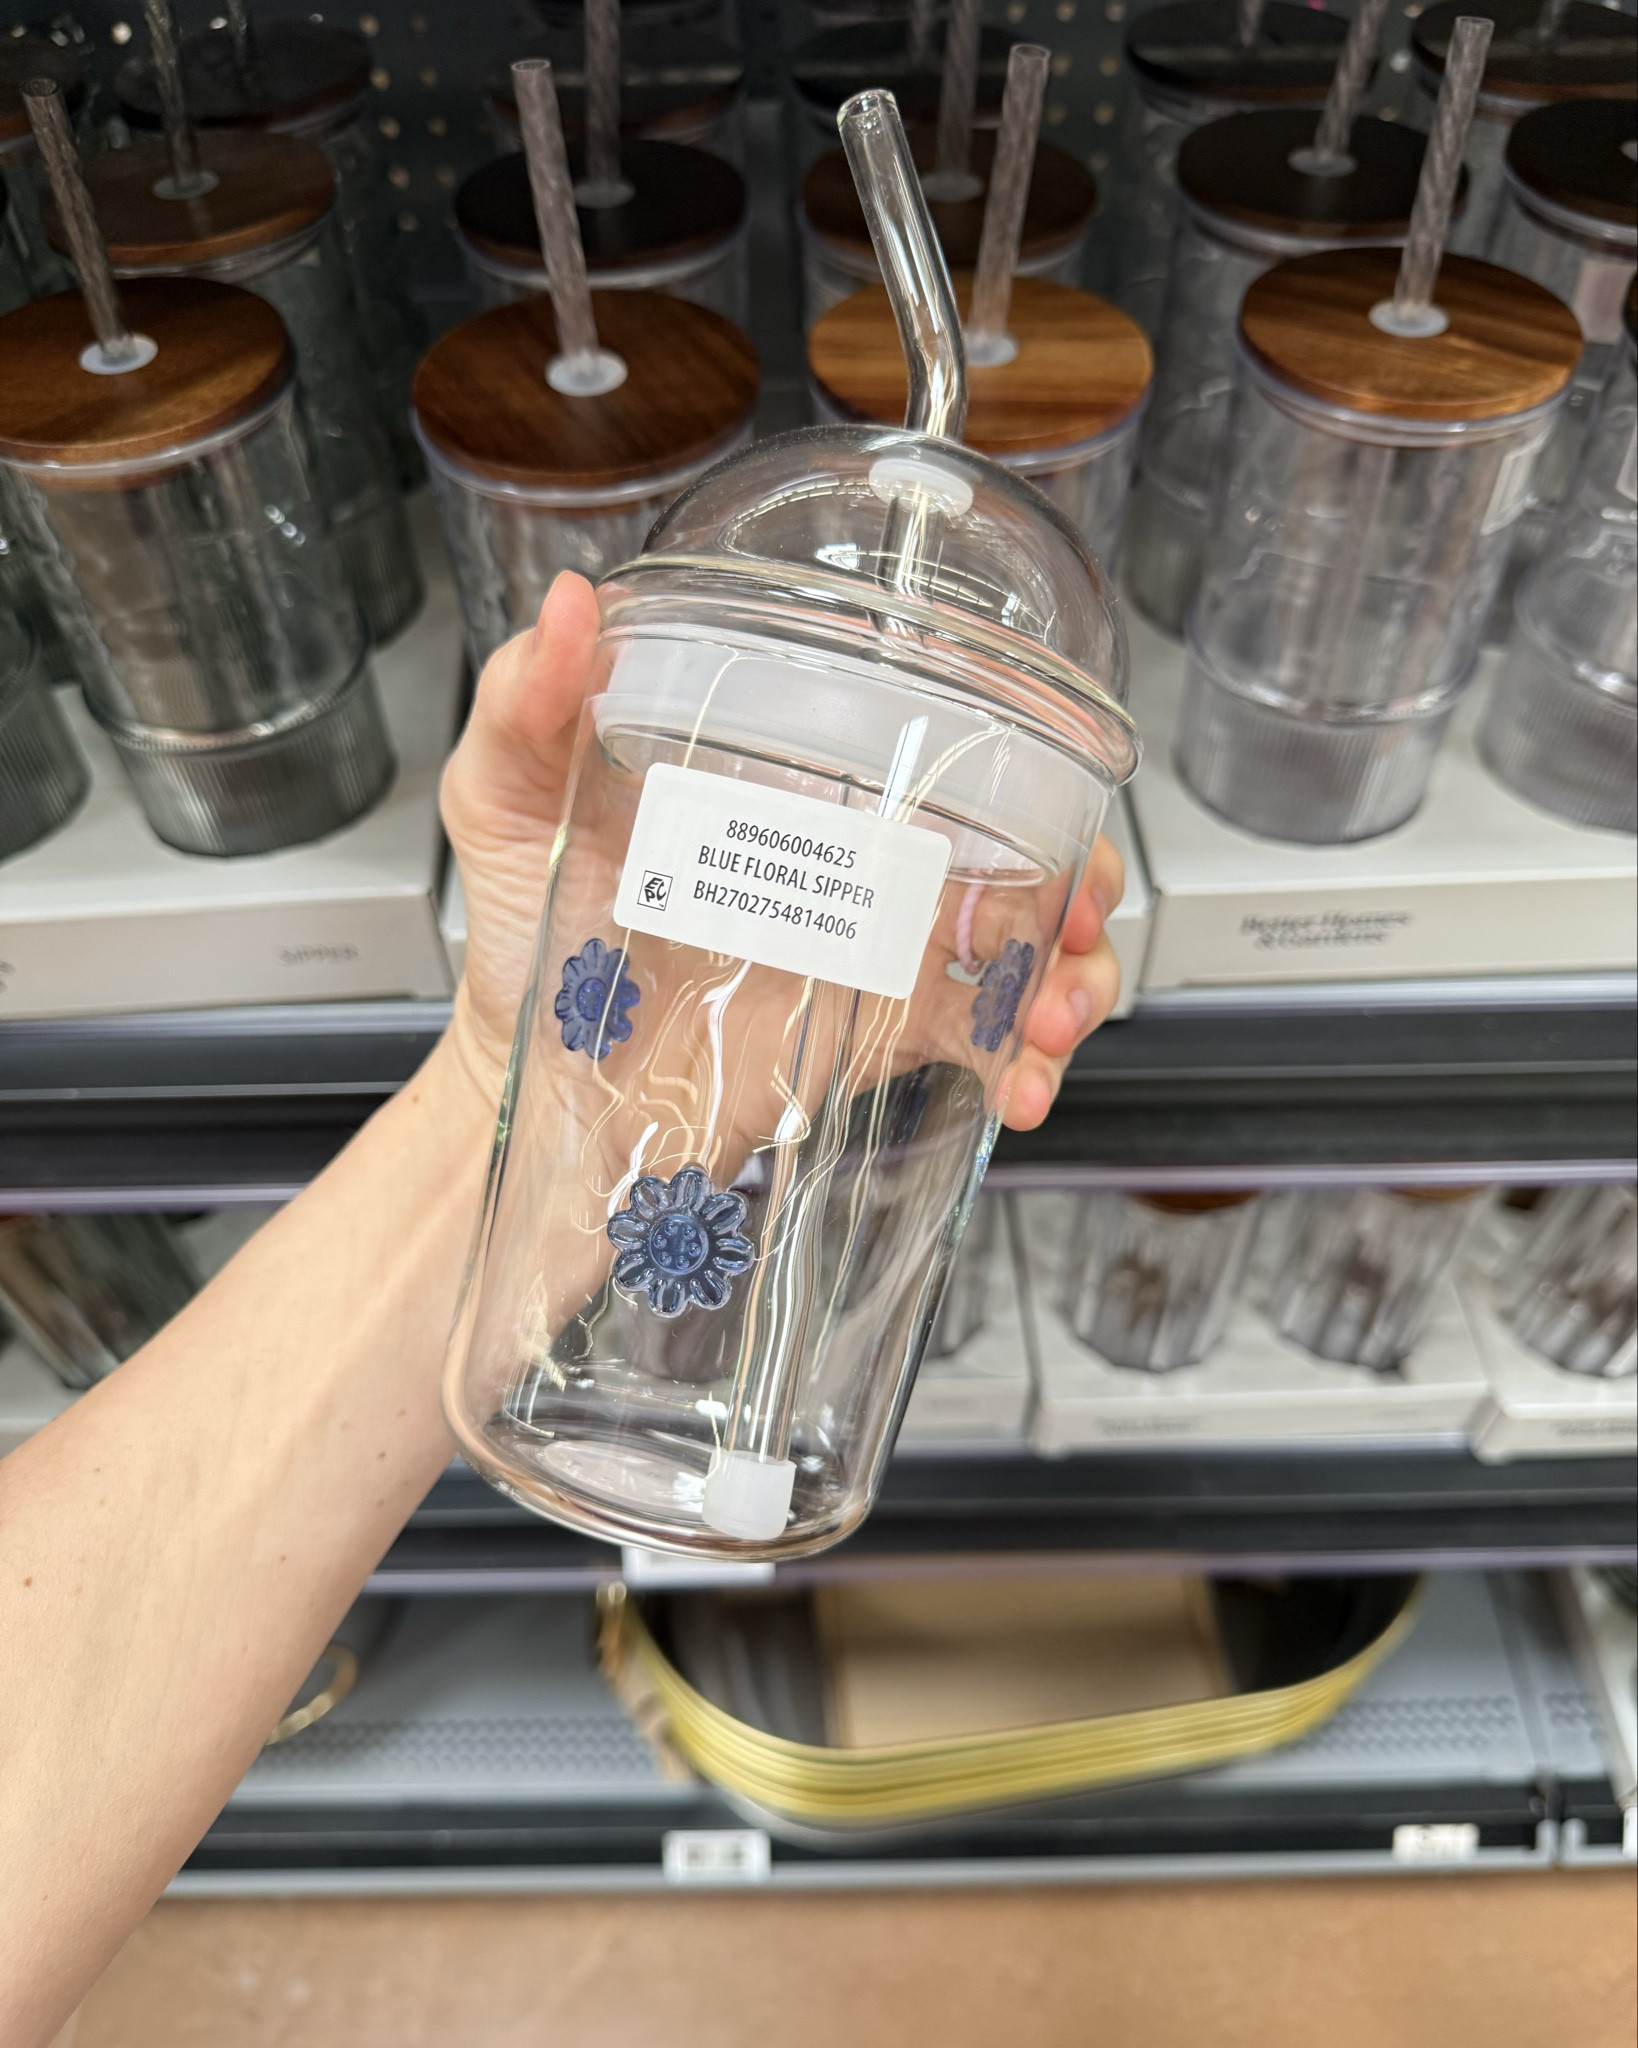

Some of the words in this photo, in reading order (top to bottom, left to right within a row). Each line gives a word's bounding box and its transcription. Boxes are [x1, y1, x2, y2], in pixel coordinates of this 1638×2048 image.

[727, 820, 857, 868] 889606004625
[699, 846, 741, 875] BLUE
[744, 857, 807, 890] FLORAL
[813, 875, 874, 908] SIPPER
[694, 880, 857, 939] BH2702754814006
